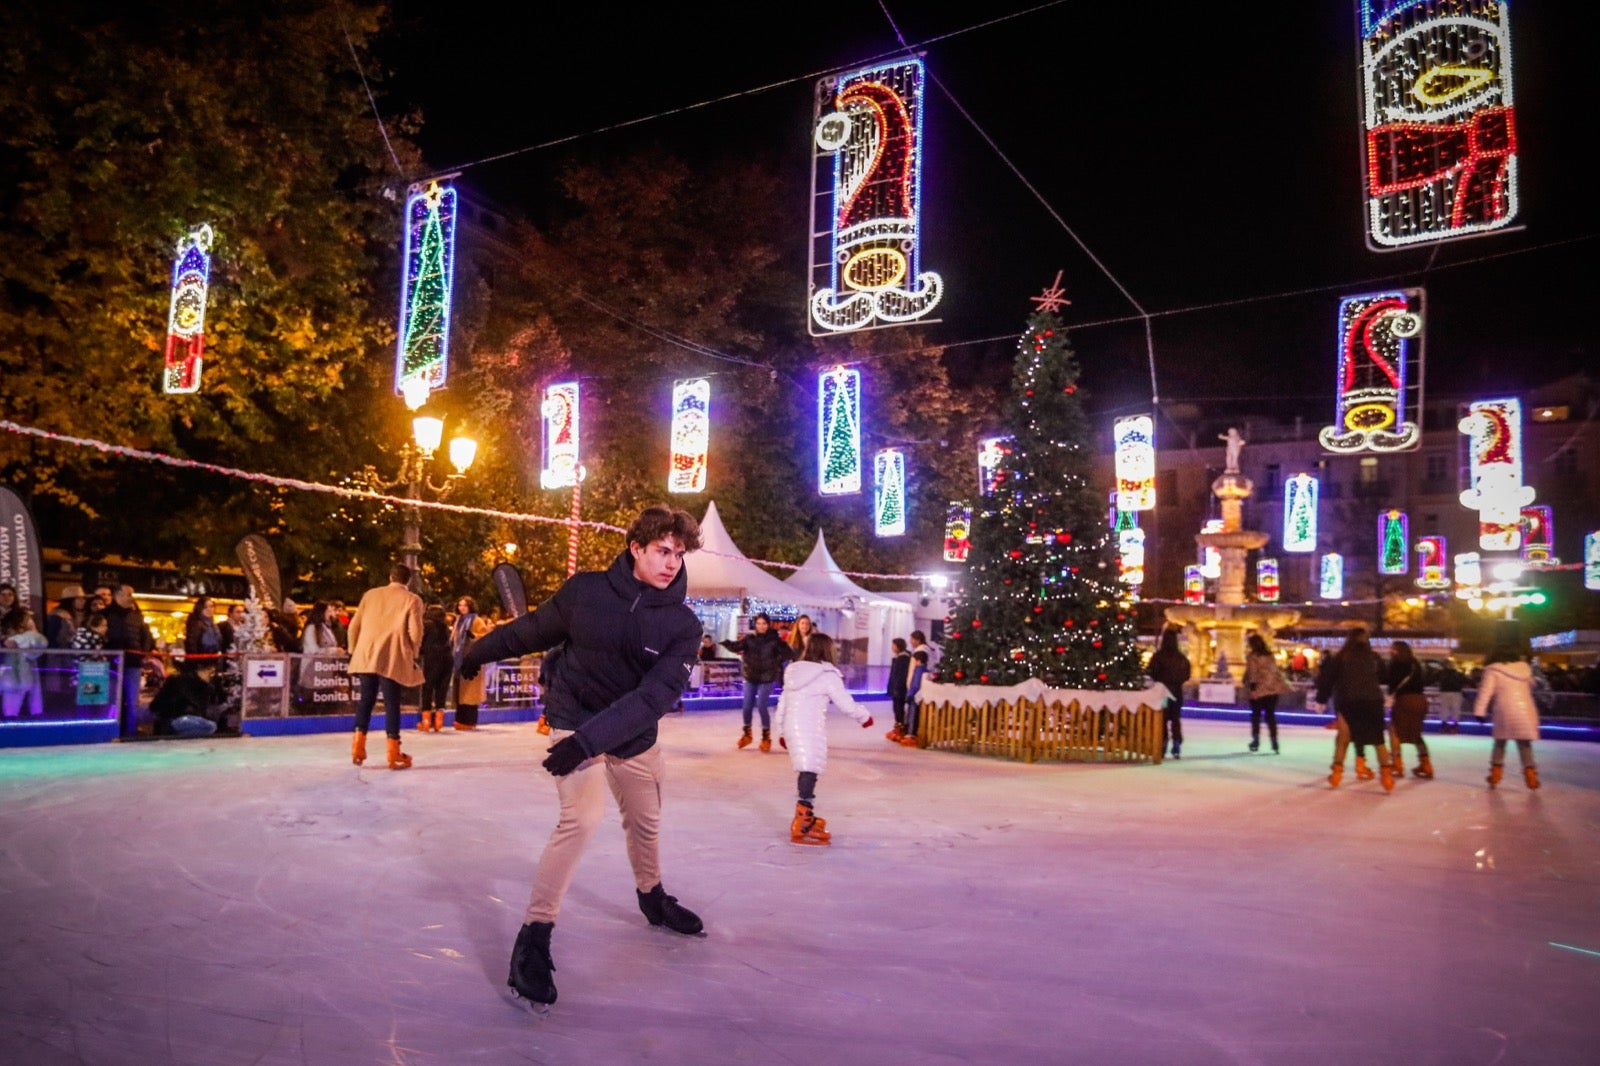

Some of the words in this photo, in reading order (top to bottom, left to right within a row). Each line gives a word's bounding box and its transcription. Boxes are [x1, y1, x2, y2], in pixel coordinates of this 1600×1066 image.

[314, 676, 349, 687] bonita
[352, 676, 361, 686] la
[503, 673, 534, 682] AEDAS
[503, 685, 533, 694] HOMES
[314, 691, 349, 702] bonita
[351, 691, 361, 701] la
